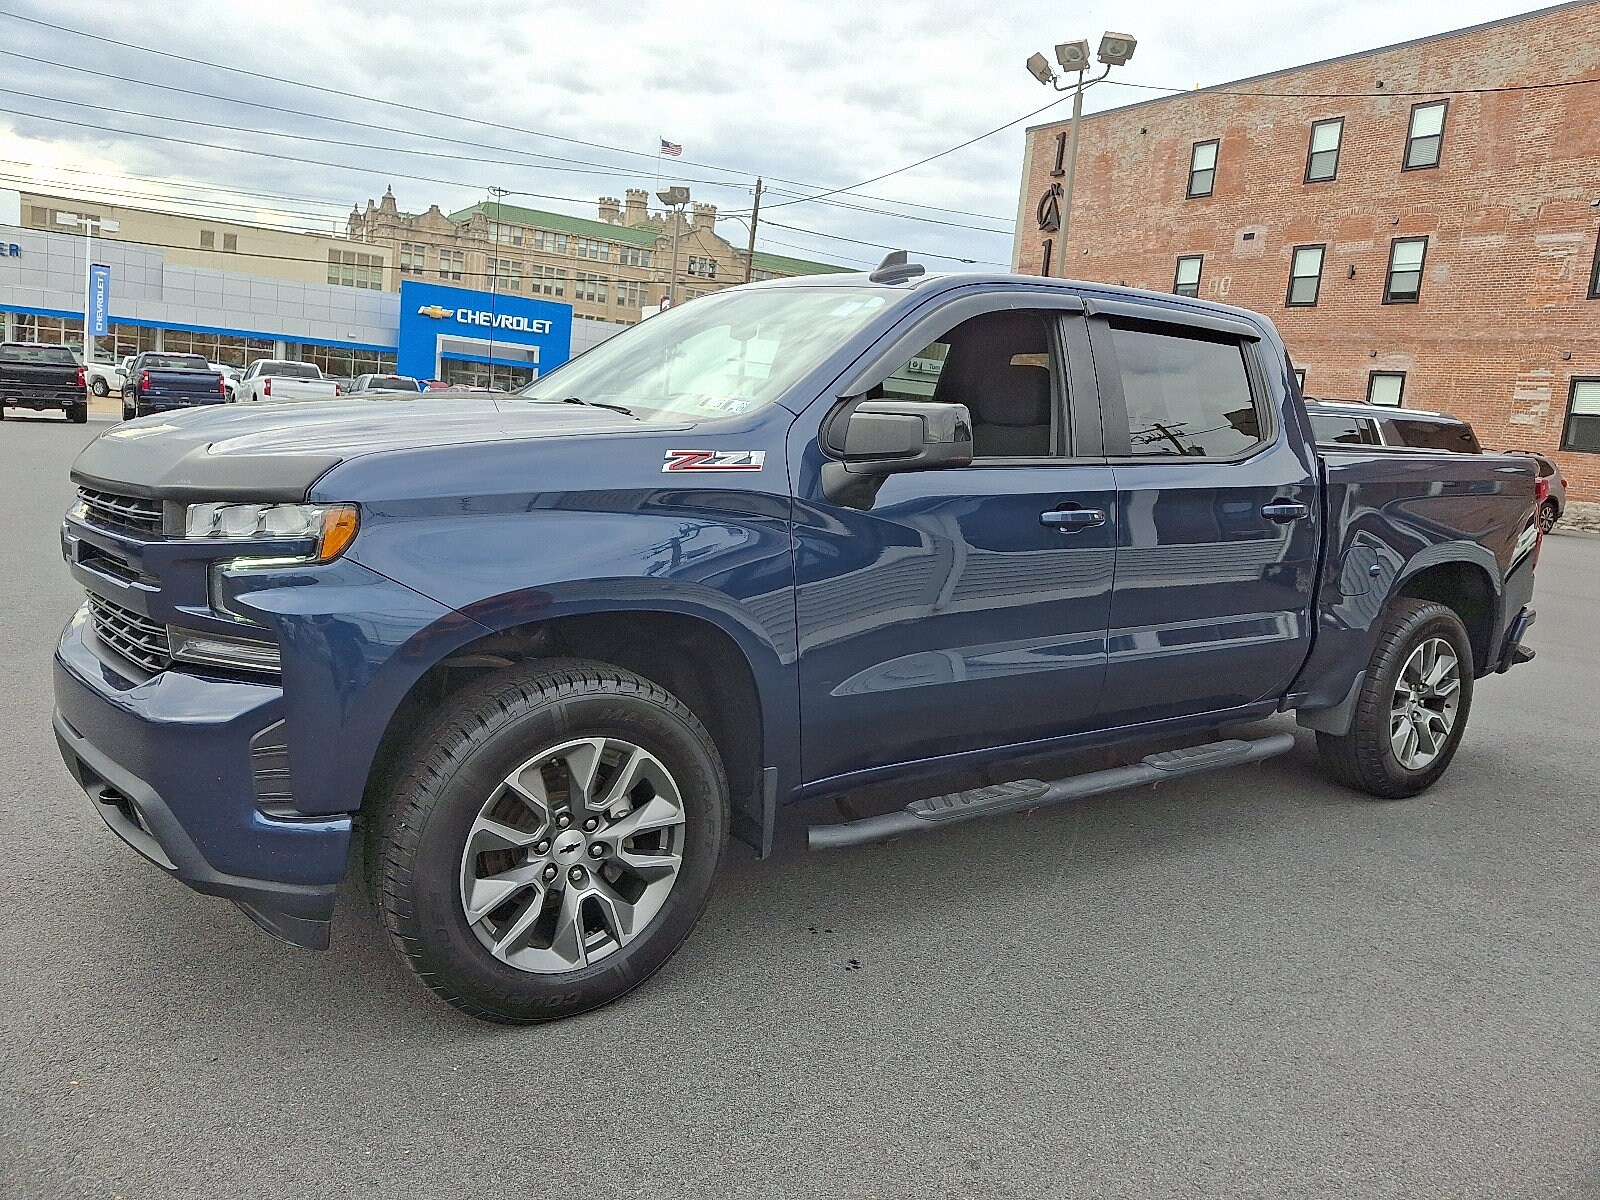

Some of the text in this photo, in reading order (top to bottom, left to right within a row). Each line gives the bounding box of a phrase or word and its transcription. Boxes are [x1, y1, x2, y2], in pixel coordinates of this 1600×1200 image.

[95, 276, 104, 332] CHEVROLET
[456, 308, 553, 335] CHEVROLET
[661, 449, 766, 473] Z71
